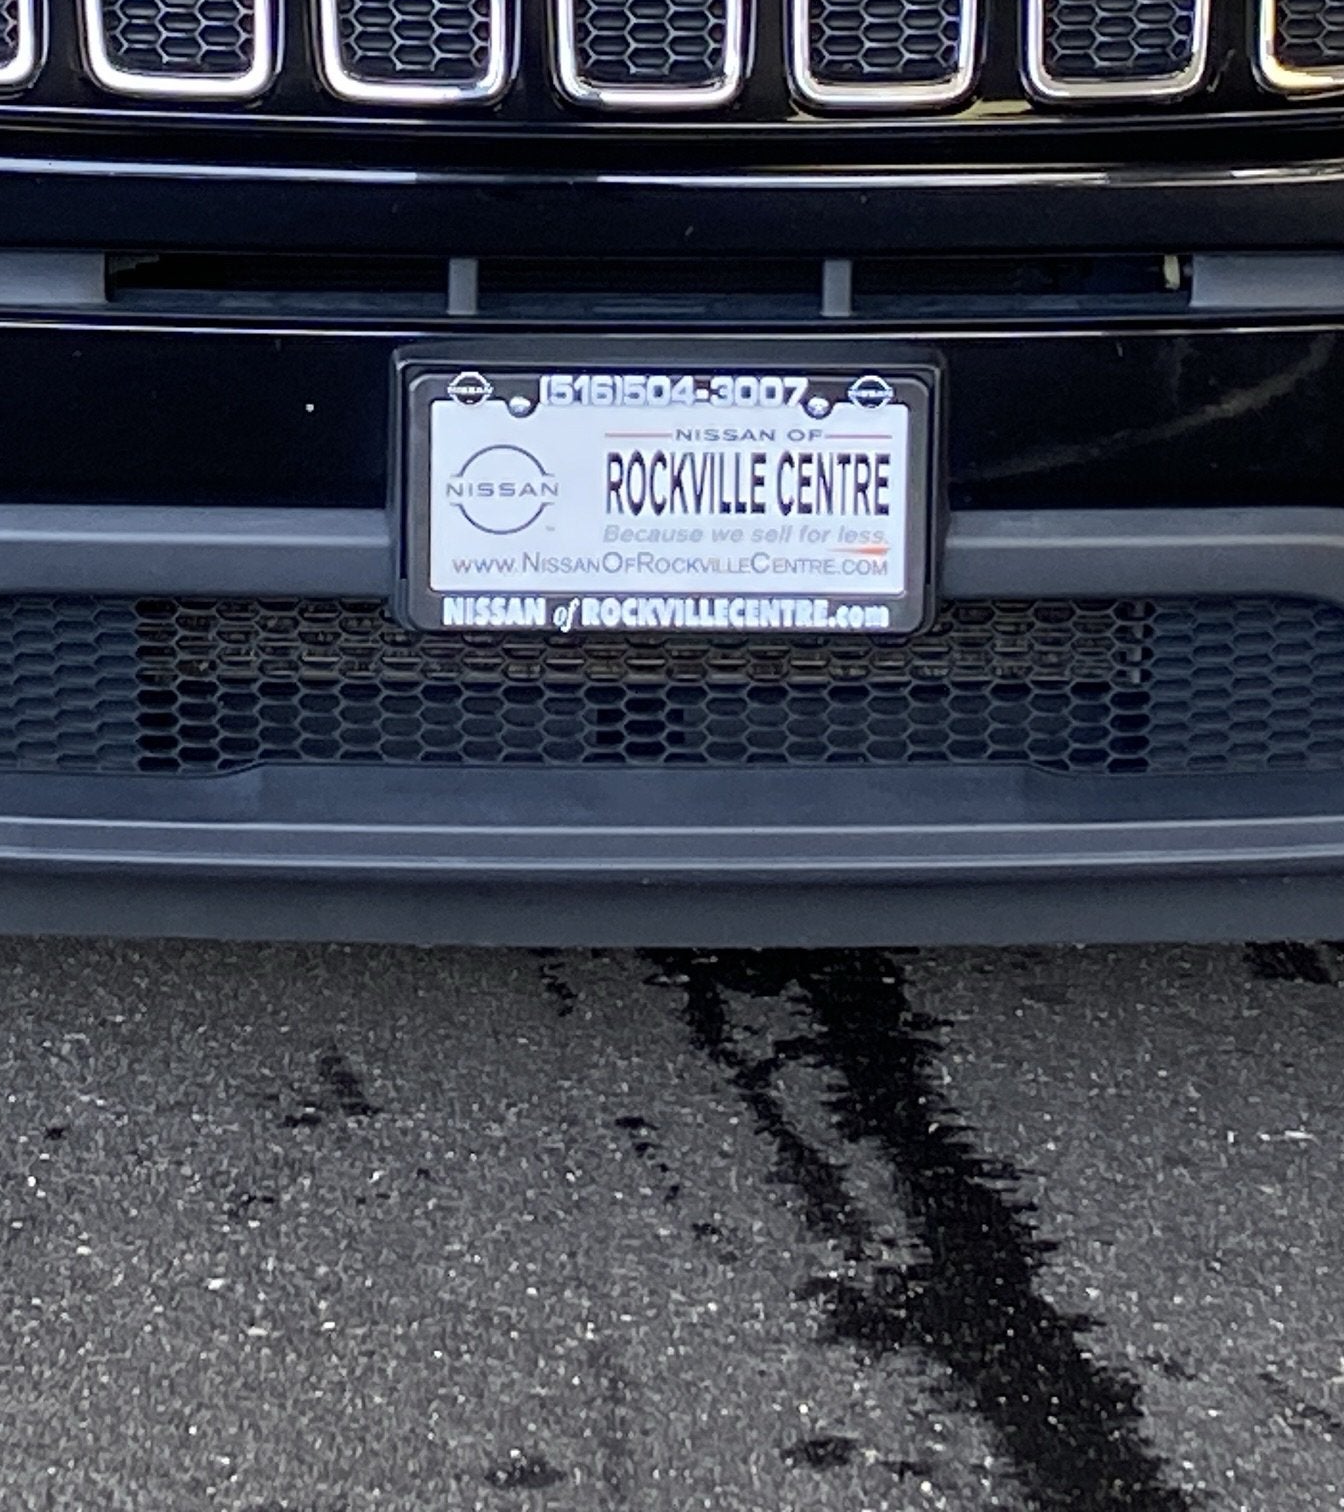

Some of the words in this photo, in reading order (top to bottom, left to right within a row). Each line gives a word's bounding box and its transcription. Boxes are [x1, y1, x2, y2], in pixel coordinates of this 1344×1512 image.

[540, 375, 808, 408] (516)504-3007
[675, 428, 776, 442] NISSAN
[787, 429, 823, 442] OF
[446, 482, 559, 497] NISSAN
[606, 450, 767, 516] ROCKVILLE
[777, 450, 891, 517] CENTRE
[603, 524, 704, 545] Because
[711, 529, 745, 544] we
[750, 525, 793, 544] sell
[799, 525, 831, 544] for
[443, 597, 546, 626] NISSAN
[553, 597, 581, 633] of
[581, 597, 890, 629] ROCKVILLECENTRE.com
